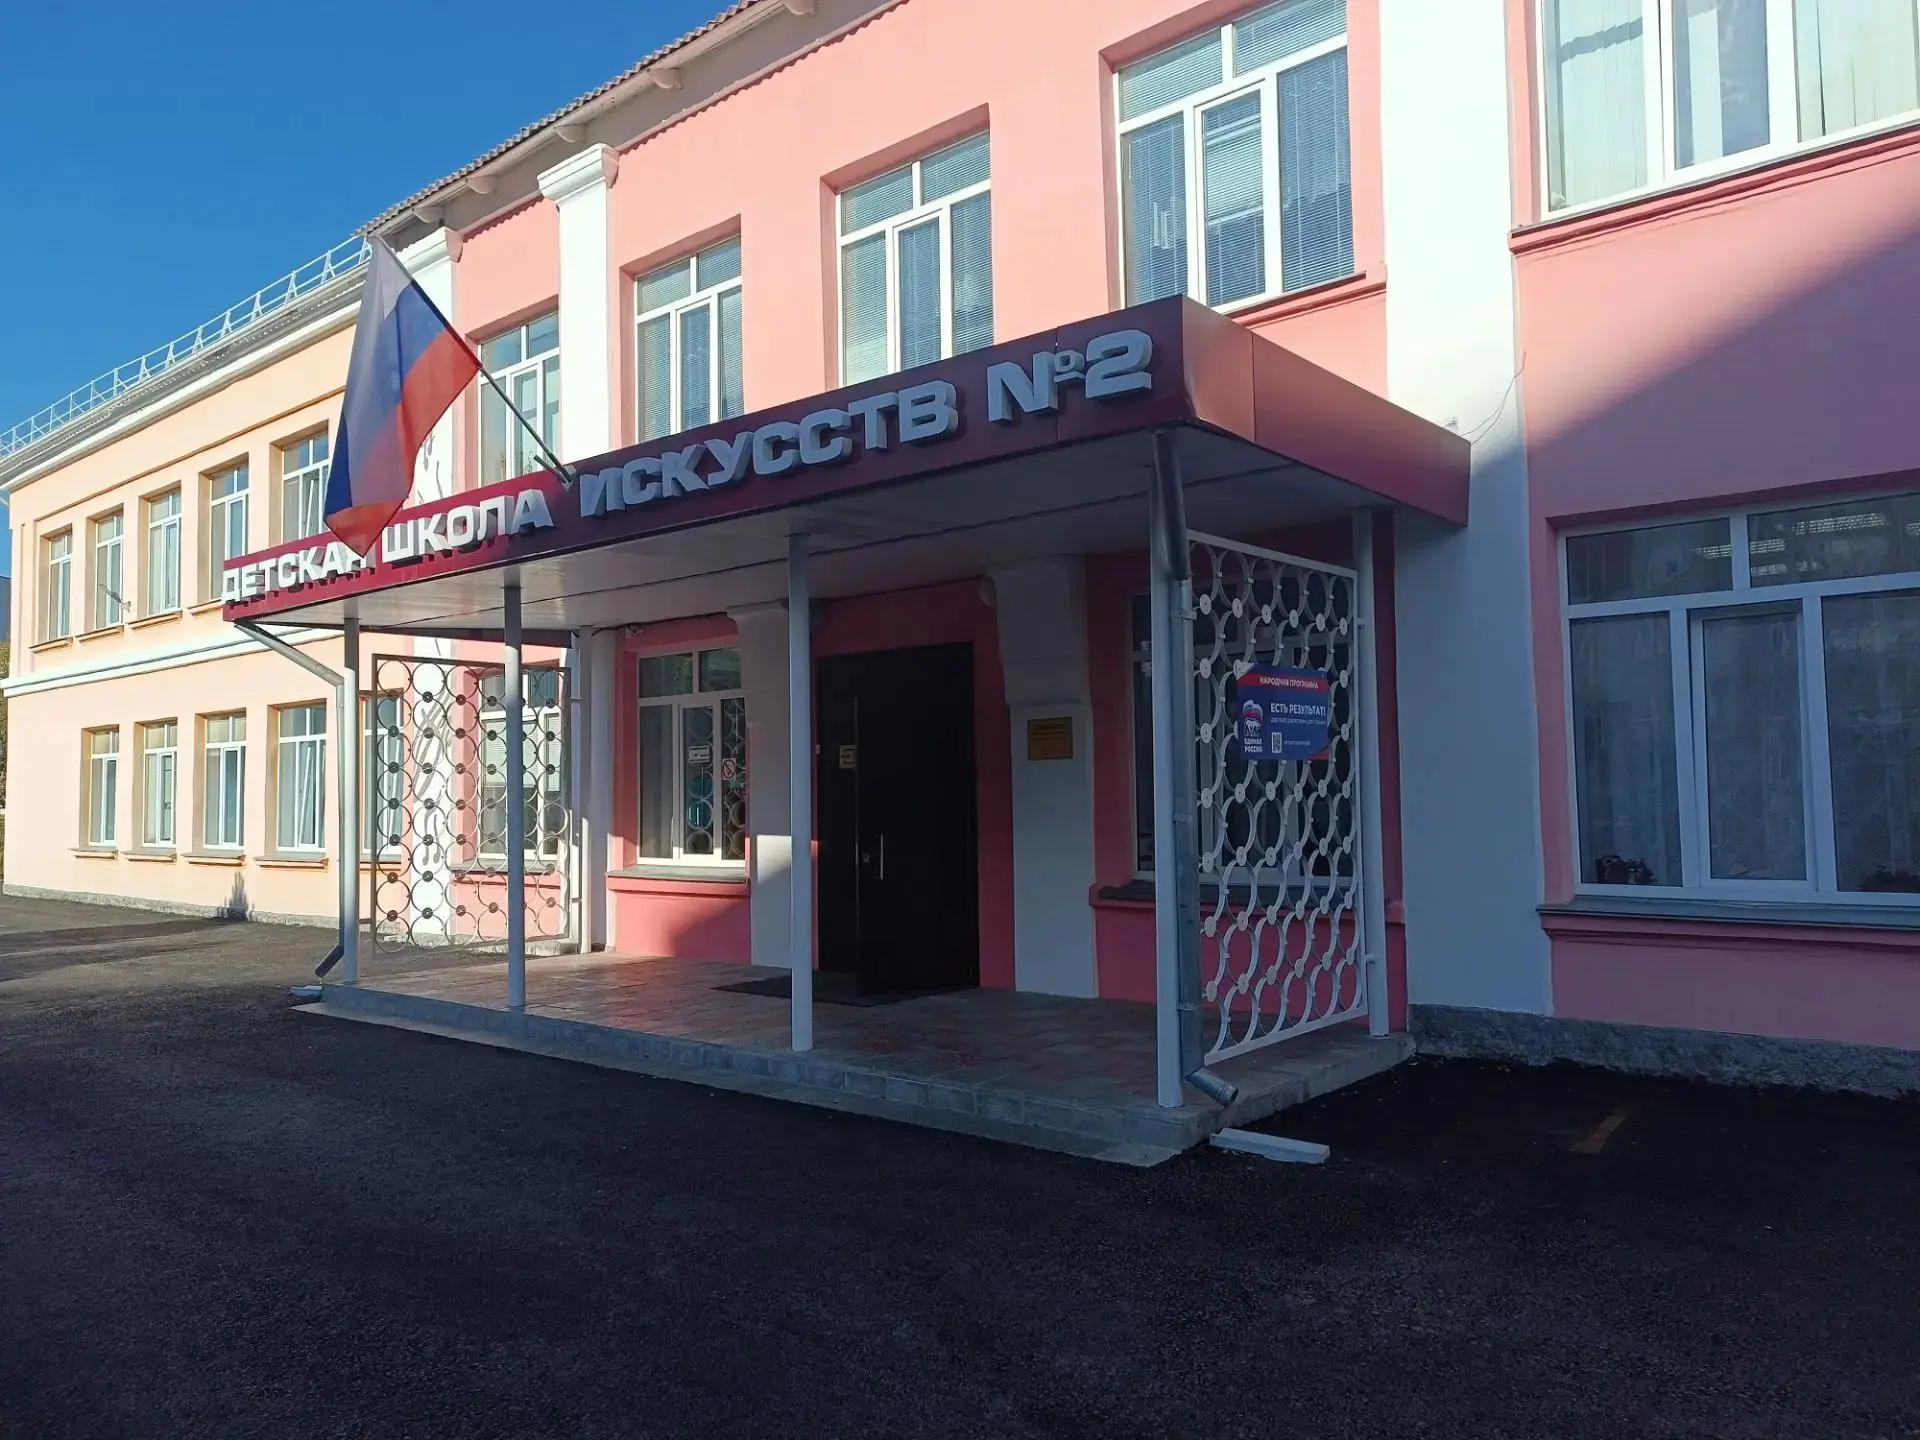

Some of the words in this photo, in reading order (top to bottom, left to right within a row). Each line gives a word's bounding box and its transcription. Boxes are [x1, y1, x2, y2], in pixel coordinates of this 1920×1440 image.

[381, 489, 555, 563] ШКОЛА
[579, 380, 958, 517] ИСКУССТВ
[1260, 677, 1289, 686] НАРОДНАЯ
[1289, 679, 1319, 689] ПРОГРАММА
[1270, 703, 1288, 713] ЕСТЬ
[1289, 704, 1326, 716] РЕЗУЛЬТАТ!
